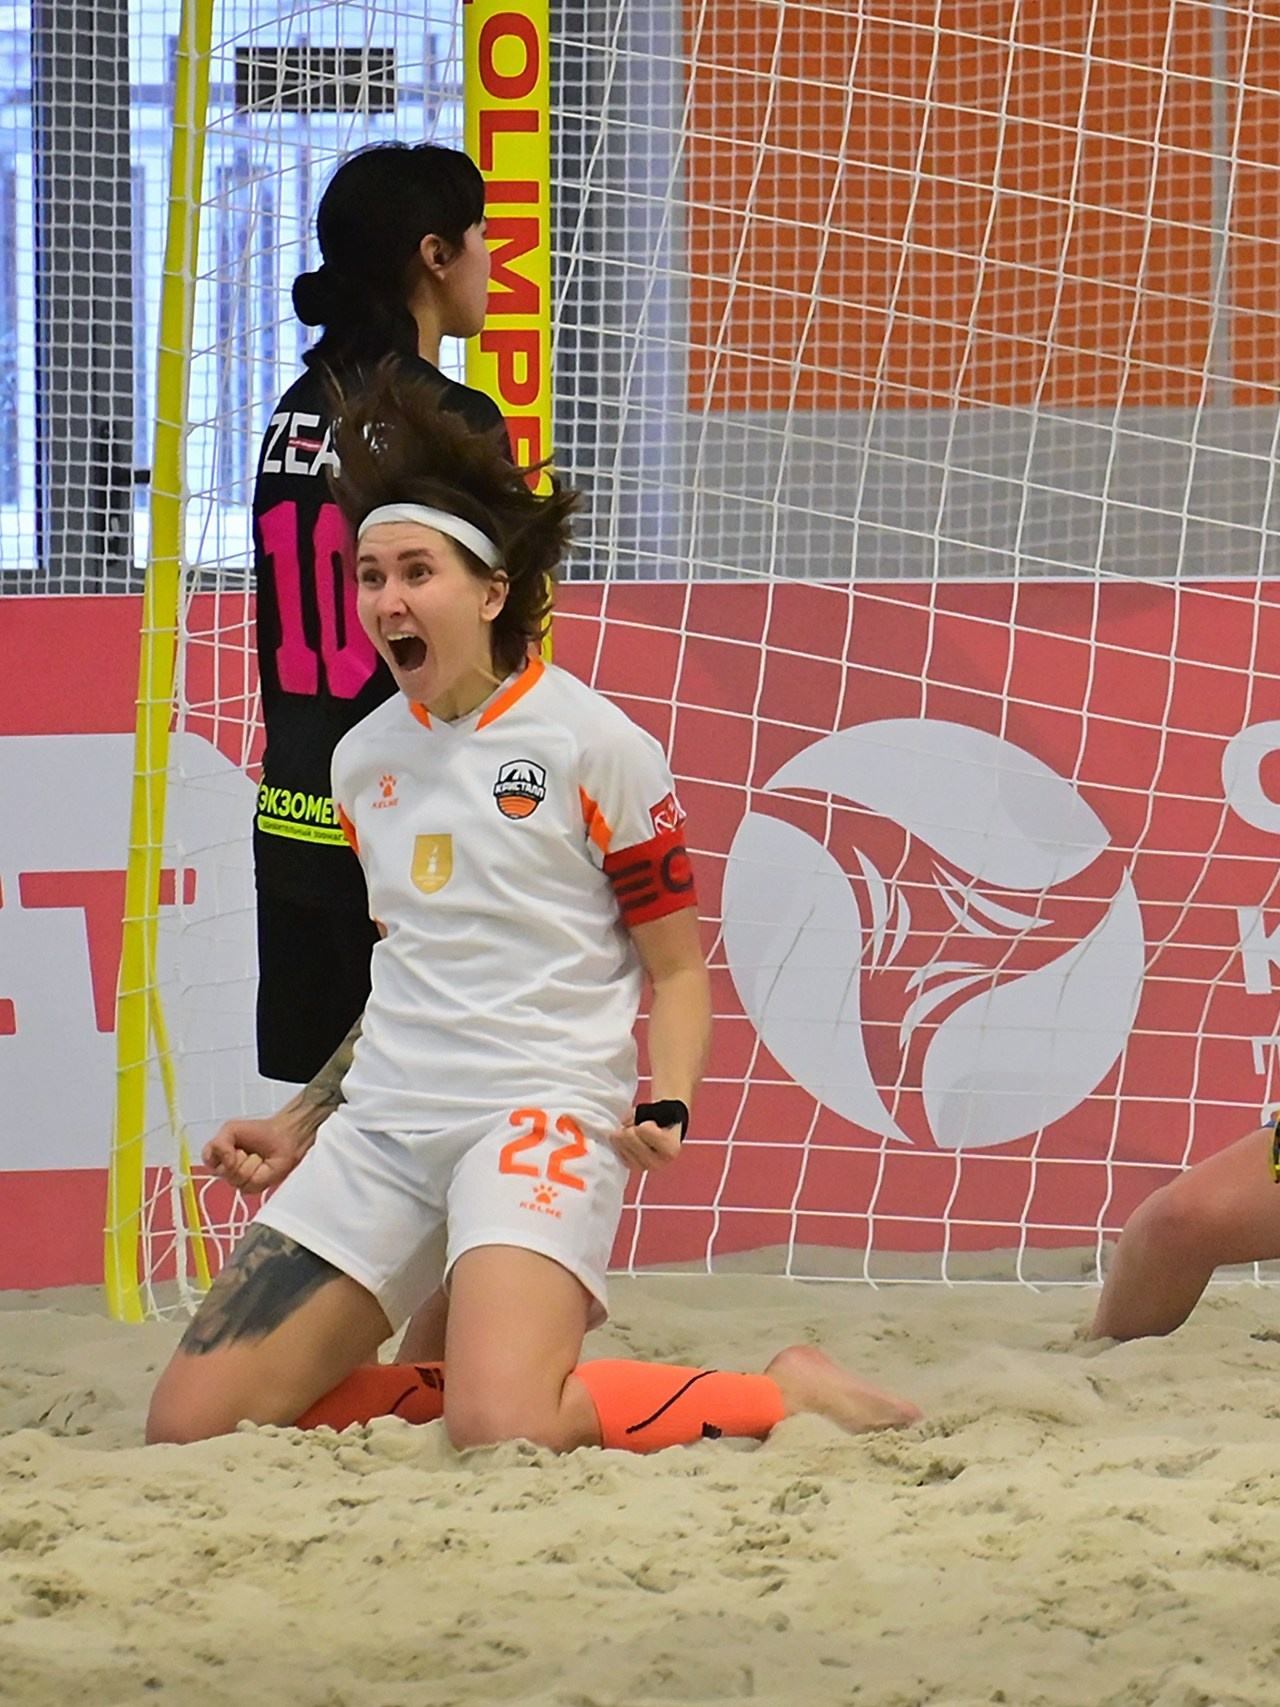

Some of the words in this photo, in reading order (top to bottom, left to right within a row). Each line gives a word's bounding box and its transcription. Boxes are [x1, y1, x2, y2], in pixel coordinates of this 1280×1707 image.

[258, 500, 378, 700] 10
[258, 784, 339, 825] ЭКЗОМЕ
[498, 1106, 588, 1192] 22
